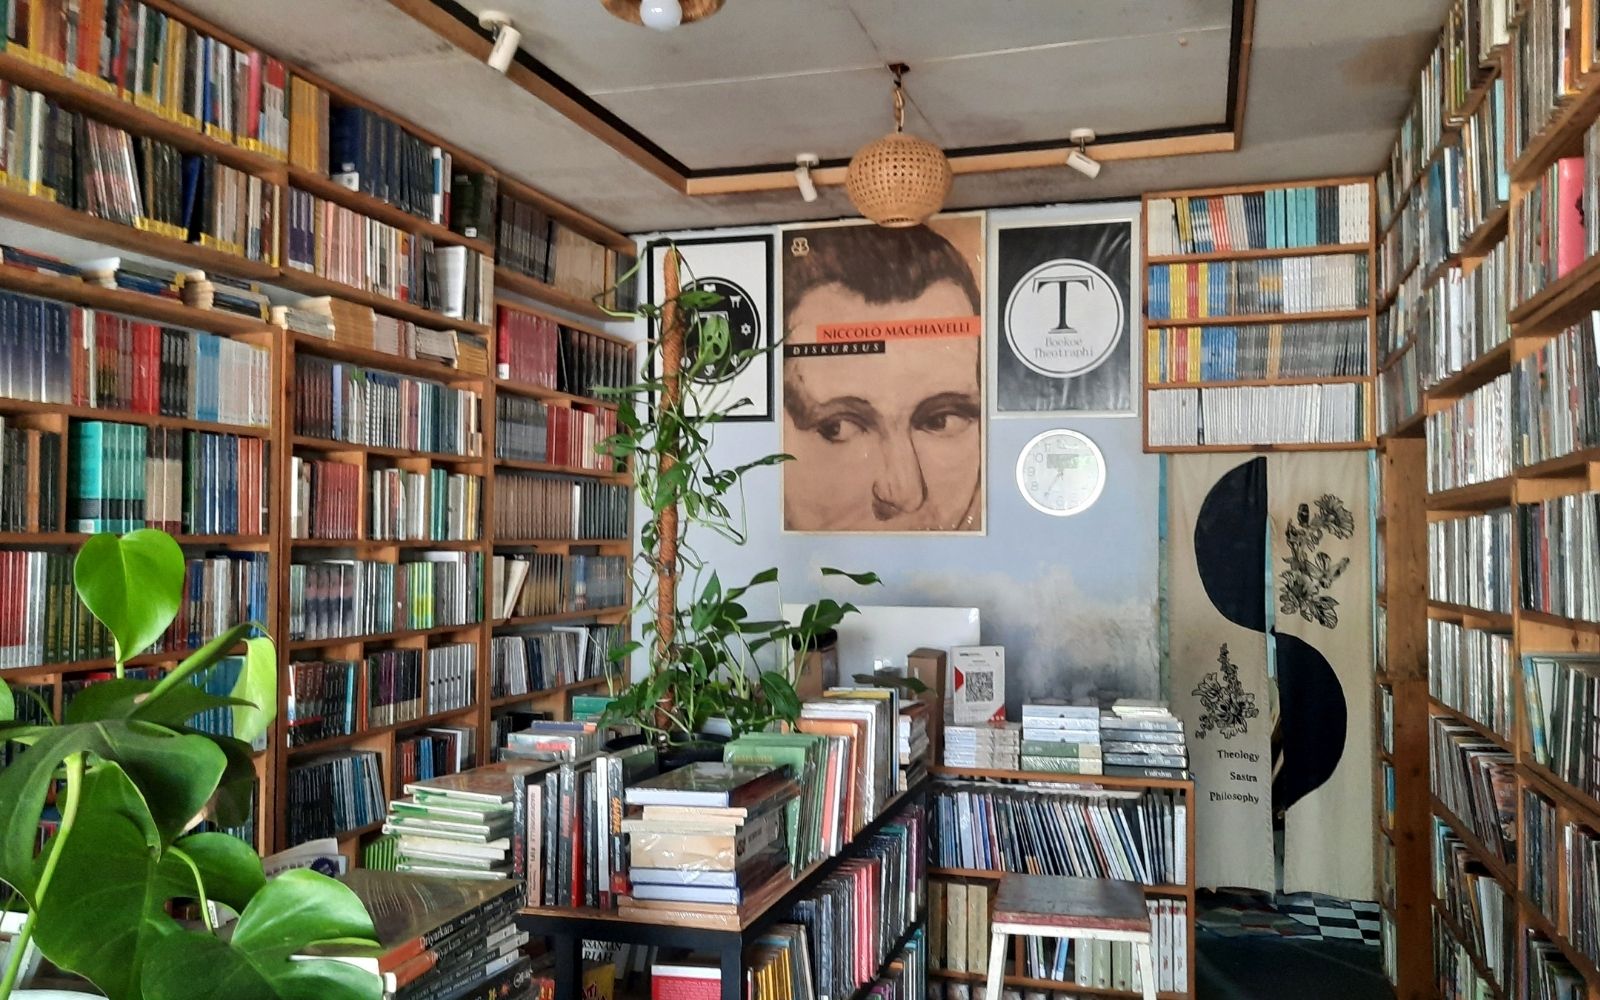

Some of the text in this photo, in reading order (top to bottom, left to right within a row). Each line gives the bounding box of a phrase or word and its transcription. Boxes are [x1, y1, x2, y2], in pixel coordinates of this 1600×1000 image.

[1032, 275, 1094, 334] T
[823, 322, 971, 340] NICCOLO MACHIAVELLI
[792, 343, 880, 356] DISKURSUS
[1217, 749, 1260, 763] Theology
[1229, 771, 1258, 783] Sastra
[1209, 791, 1260, 804] Philosophy
